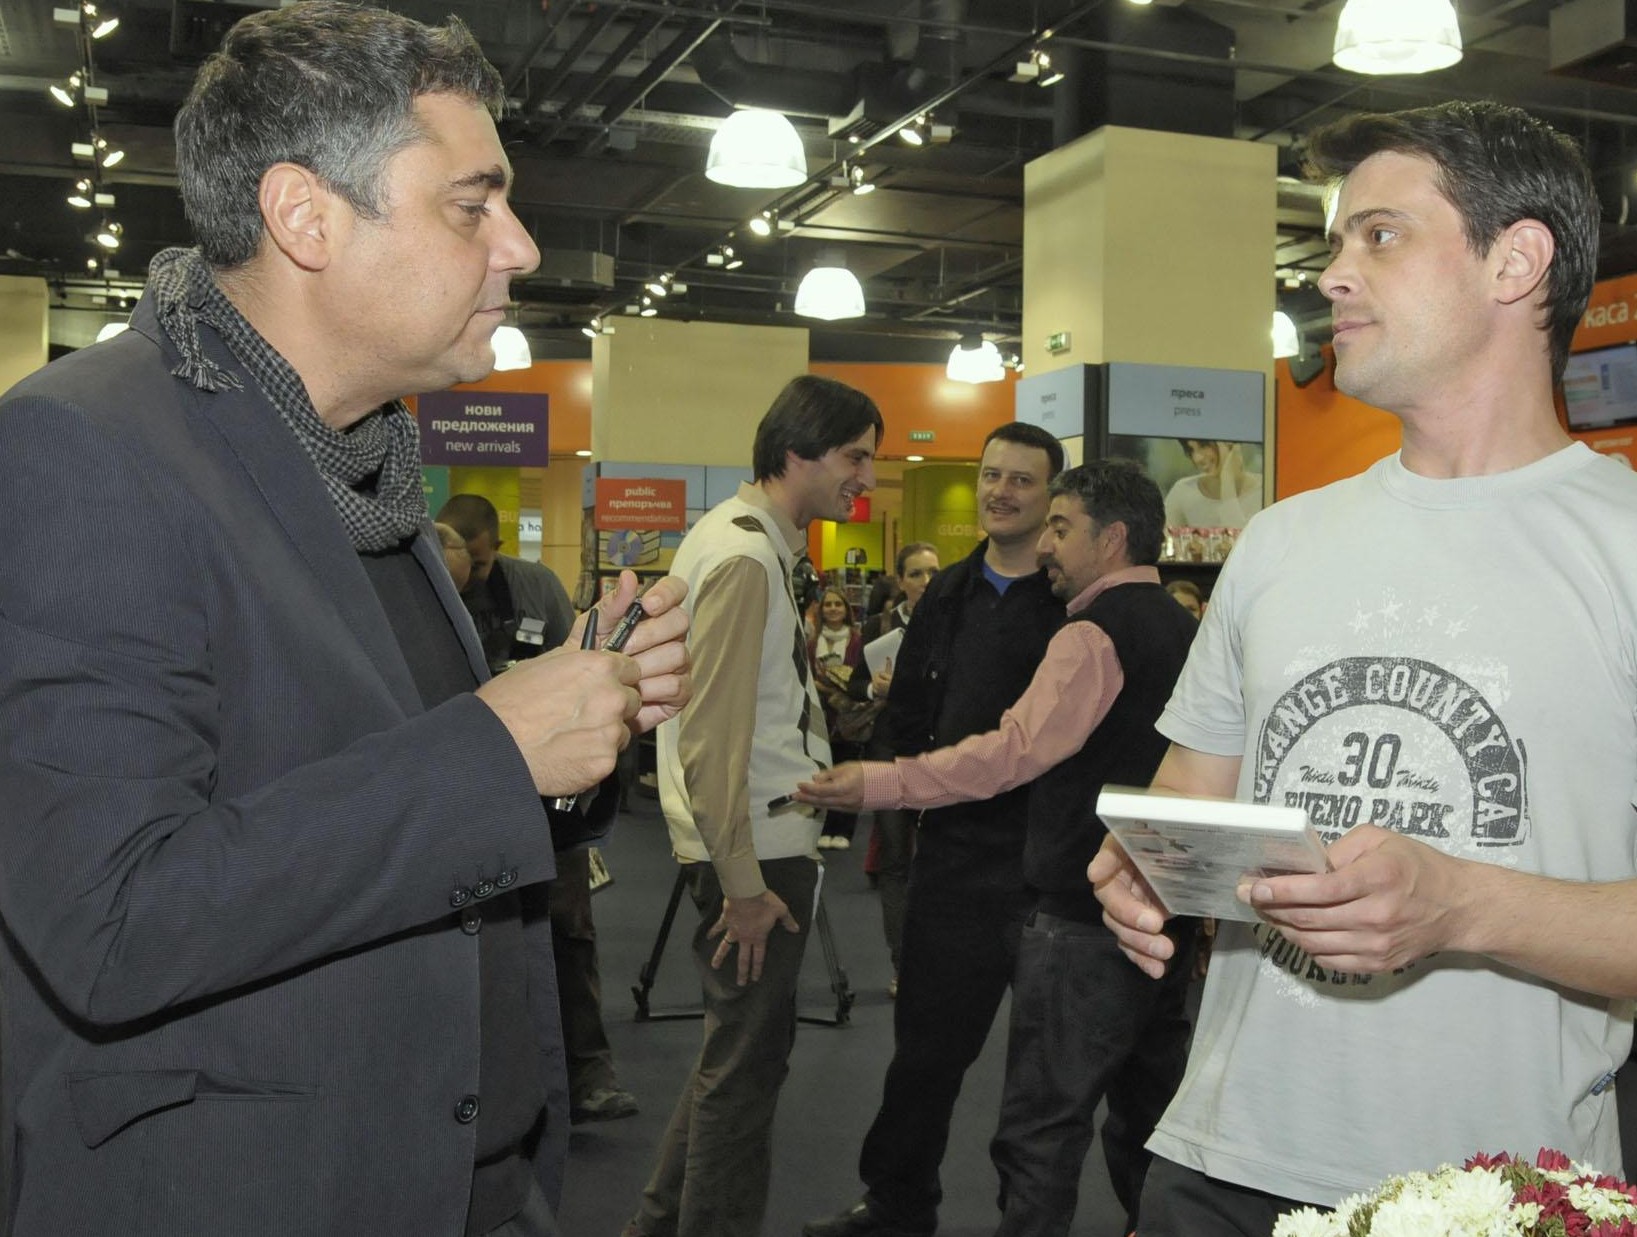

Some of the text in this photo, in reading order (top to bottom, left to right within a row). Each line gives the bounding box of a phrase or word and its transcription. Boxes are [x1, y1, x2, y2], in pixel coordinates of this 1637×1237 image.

[1171, 388, 1205, 399] преса
[464, 404, 502, 416] нови
[1173, 406, 1202, 417] press
[431, 419, 535, 433] предложения
[445, 438, 521, 453] new arrivals
[624, 487, 657, 497] public
[608, 500, 672, 511] препоръчва
[601, 514, 680, 524] recommendations
[1365, 663, 1508, 757] COUNTY
[1337, 731, 1402, 789] 30
[1369, 798, 1454, 838] PARK
